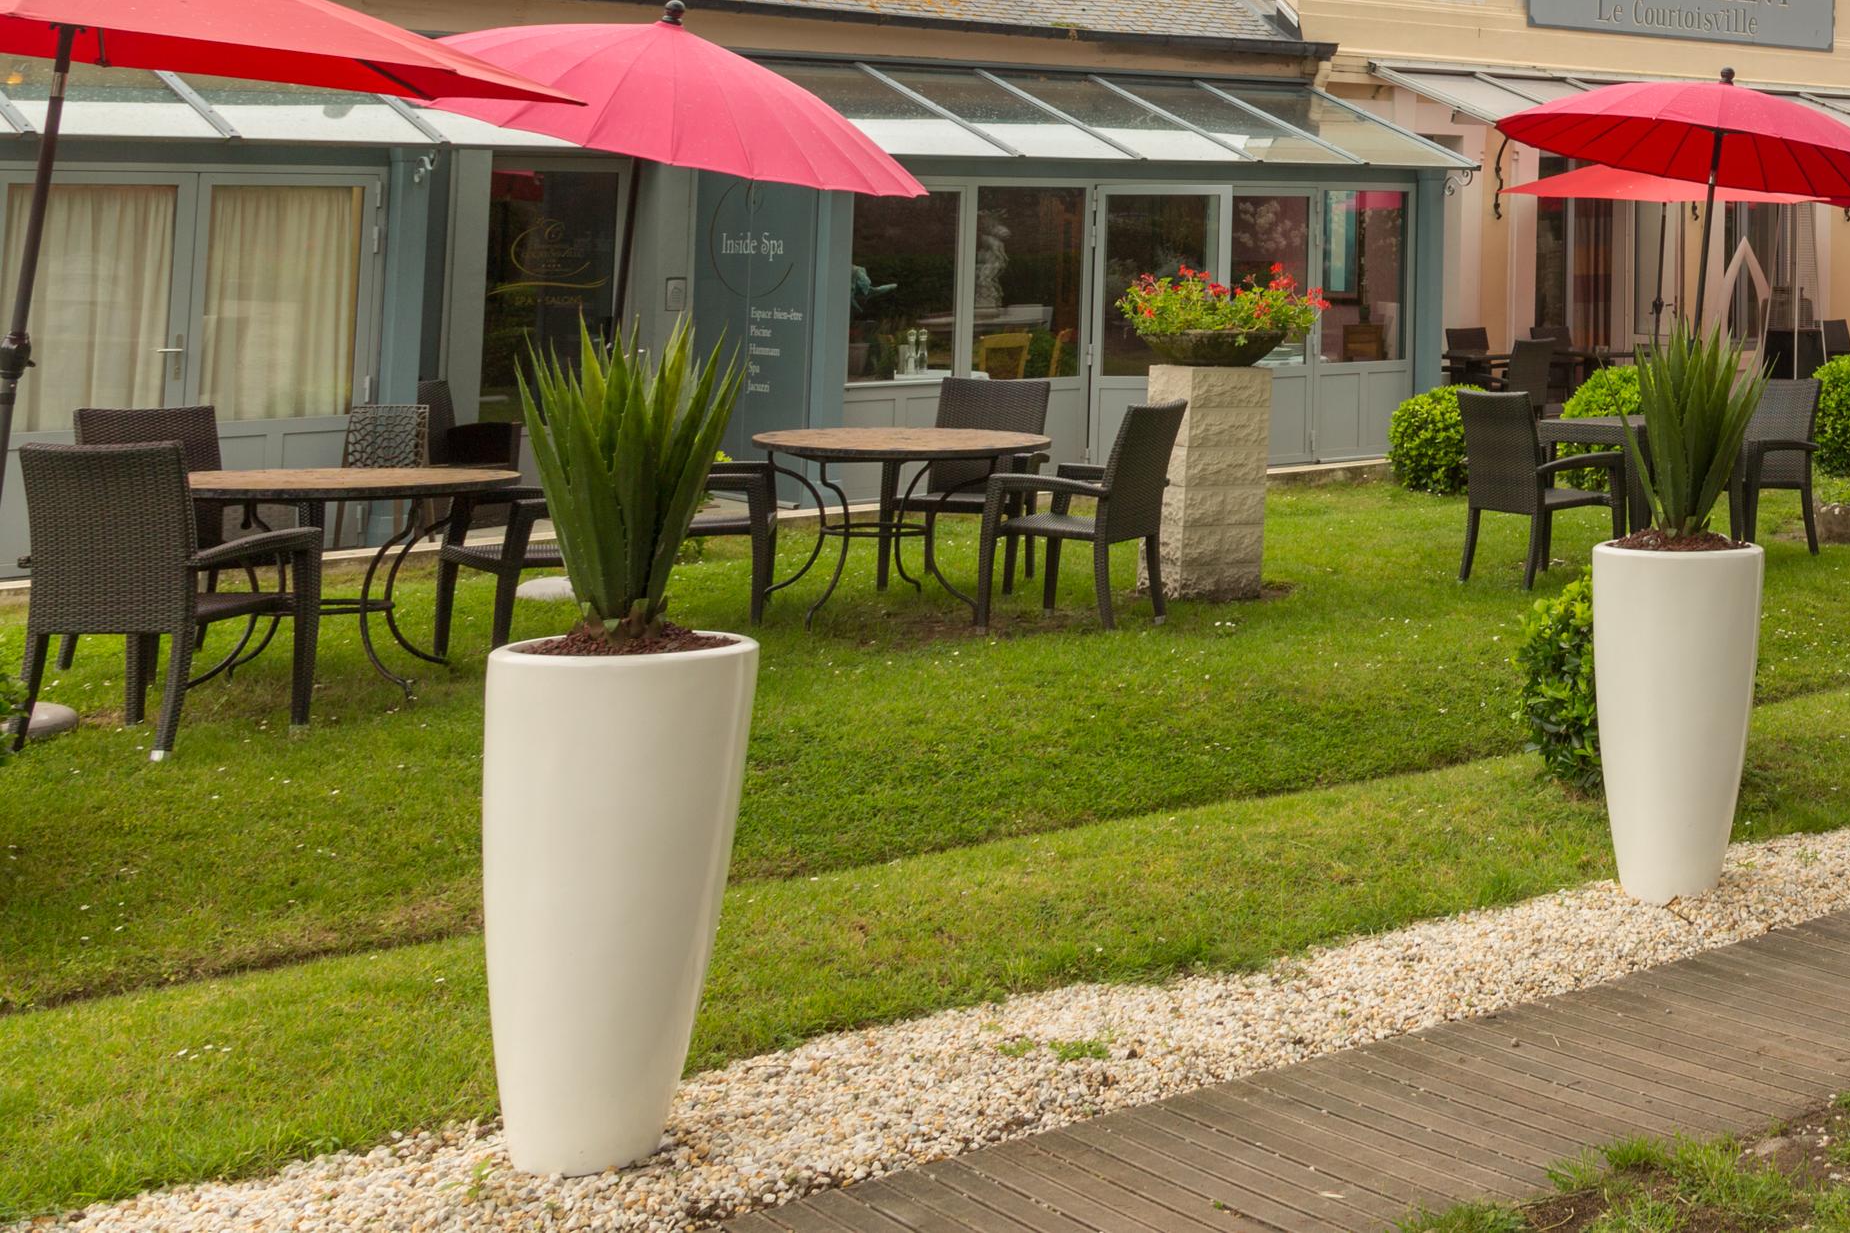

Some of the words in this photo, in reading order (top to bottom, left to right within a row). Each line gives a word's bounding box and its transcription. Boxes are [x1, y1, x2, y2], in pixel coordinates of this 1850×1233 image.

[721, 232, 758, 255] Inside
[760, 232, 784, 262] Spa
[750, 307, 772, 322] Espace
[750, 324, 773, 337] Piscine
[748, 361, 760, 375] Spa
[746, 379, 770, 394] Jacuzzi
